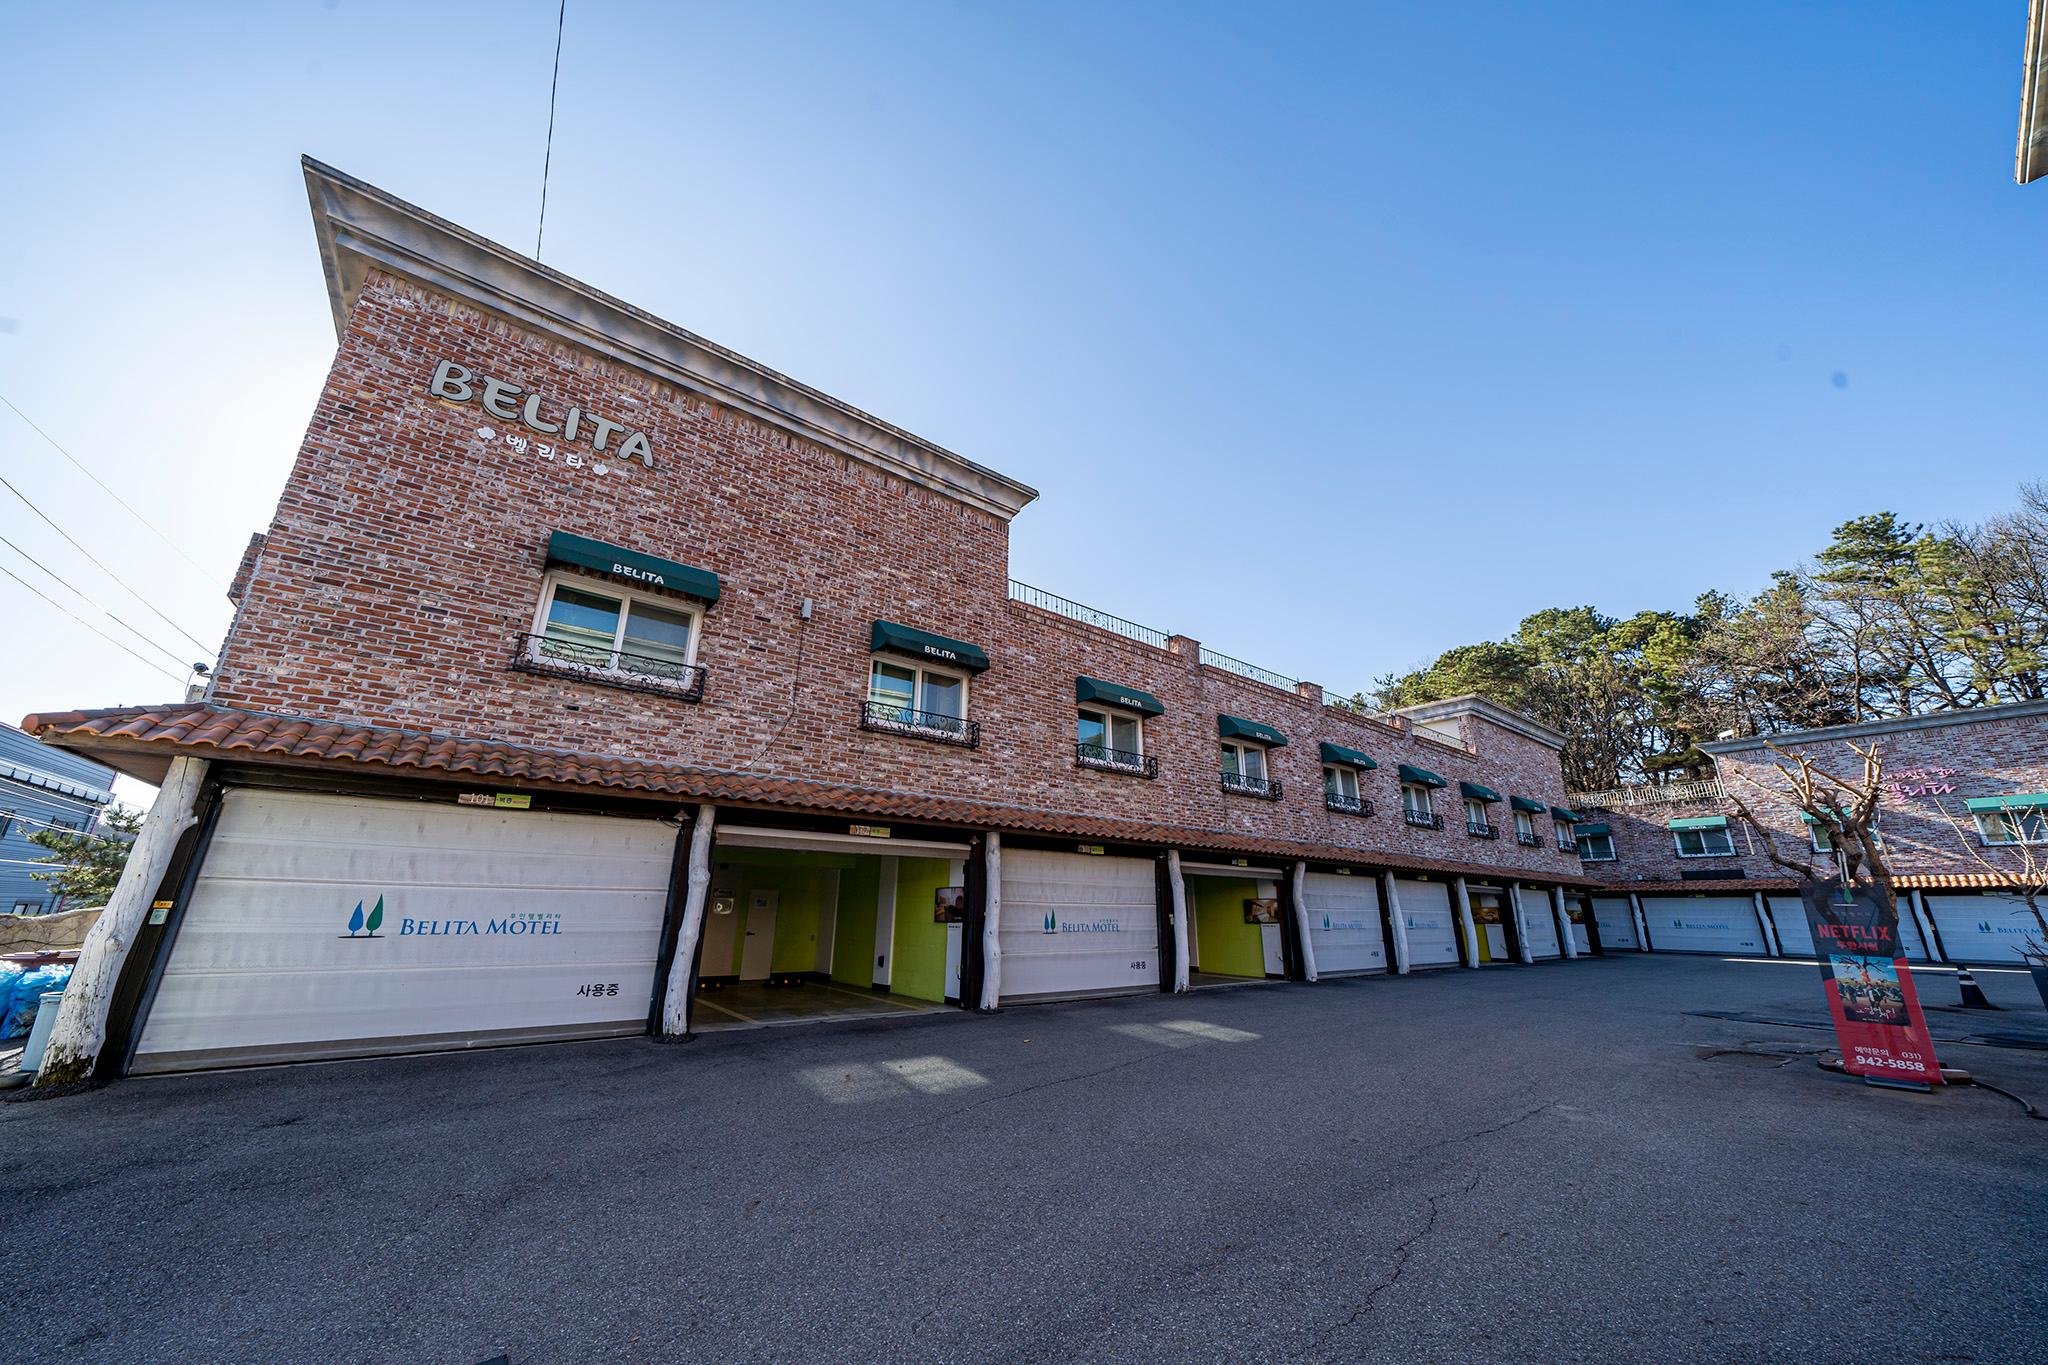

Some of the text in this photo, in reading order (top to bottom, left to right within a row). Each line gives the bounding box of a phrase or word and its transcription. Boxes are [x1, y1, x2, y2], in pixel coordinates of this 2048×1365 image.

[430, 359, 654, 469] BELITA
[506, 434, 585, 469] 벨리타
[612, 563, 664, 585] BELITA
[924, 645, 956, 660] BELITA
[1120, 696, 1142, 708] BELITA
[400, 918, 562, 935] BELITA MOTEL
[1062, 922, 1119, 933] BELITA MOTEL
[1817, 924, 1891, 941] NETFLIX
[1130, 961, 1146, 970] 사용중
[577, 983, 619, 997] 사용중
[1854, 1046, 1922, 1061] 예약문의 031)
[1856, 1055, 1925, 1072] 942-5858
